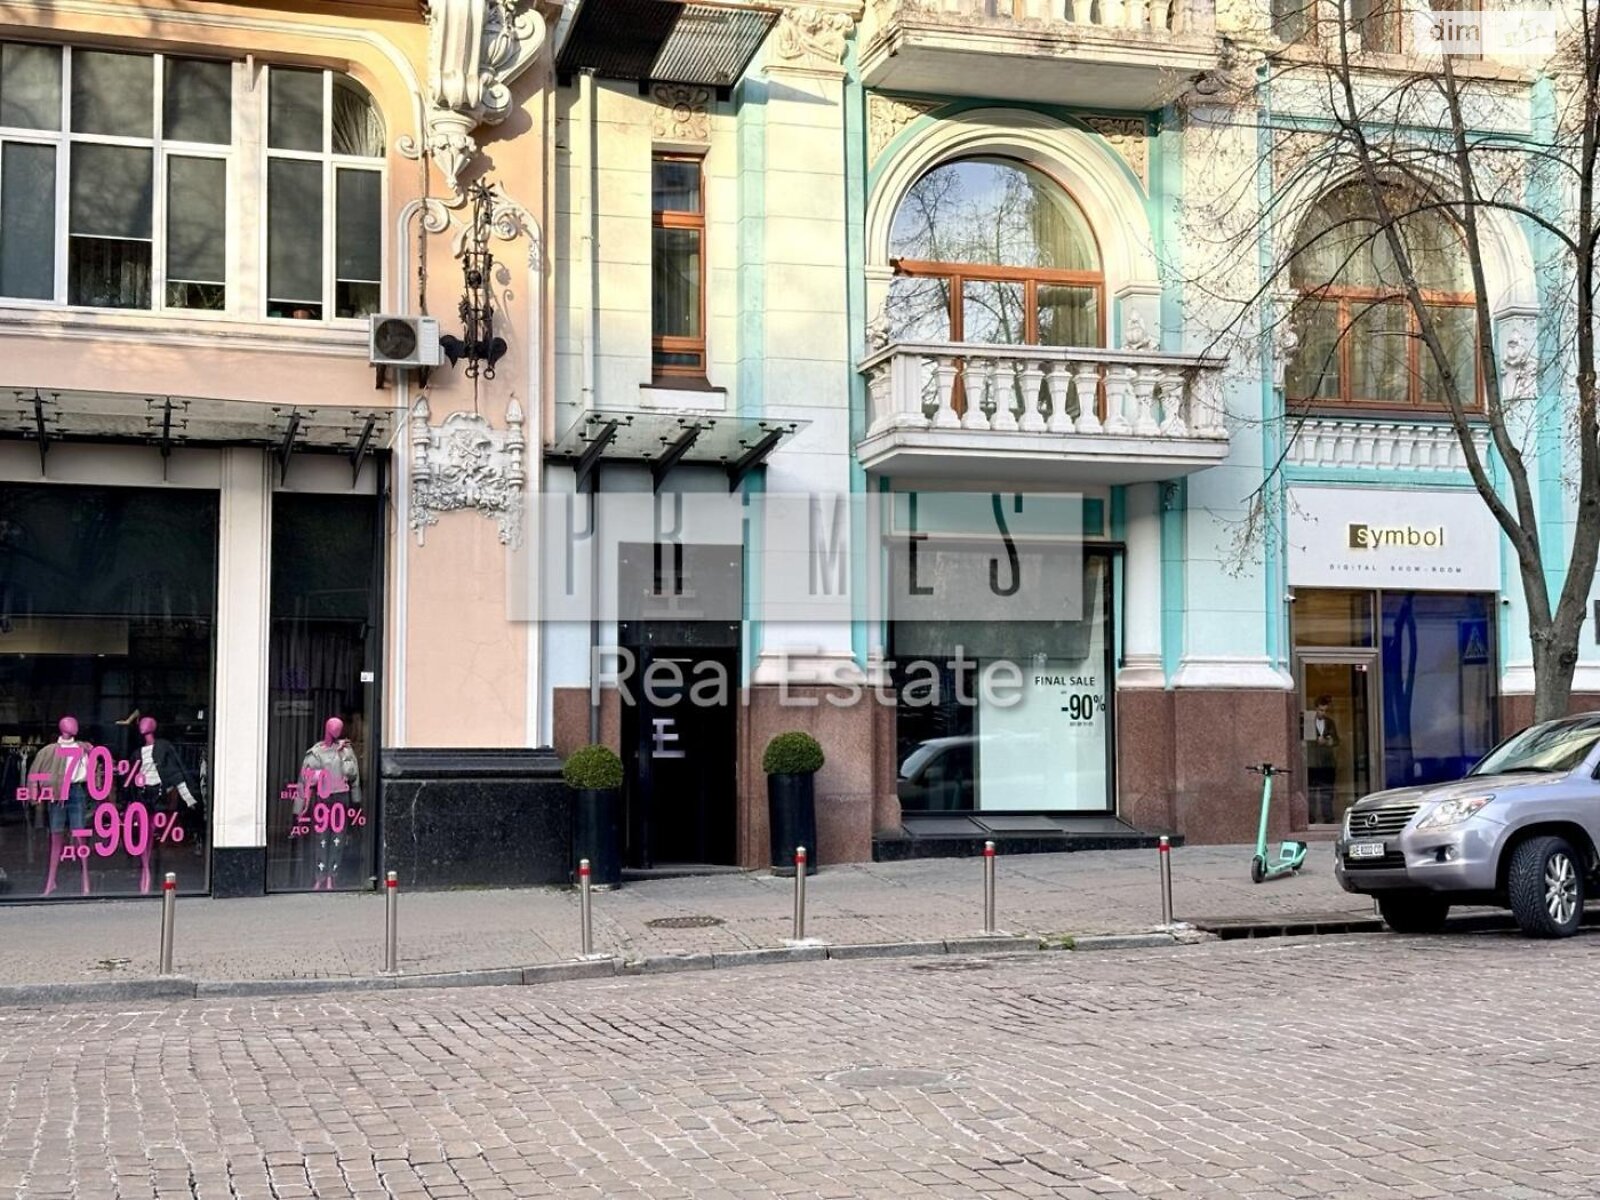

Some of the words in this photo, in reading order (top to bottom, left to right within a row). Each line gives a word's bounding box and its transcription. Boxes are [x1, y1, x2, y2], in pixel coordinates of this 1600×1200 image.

[1356, 526, 1444, 548] symbol
[1034, 676, 1067, 686] FINAL
[1069, 676, 1096, 686] SALE
[1061, 694, 1106, 720] -90%
[28, 746, 146, 800] -70%
[72, 802, 184, 857] -90%
[298, 802, 366, 833] -90%
[60, 845, 91, 861] до
